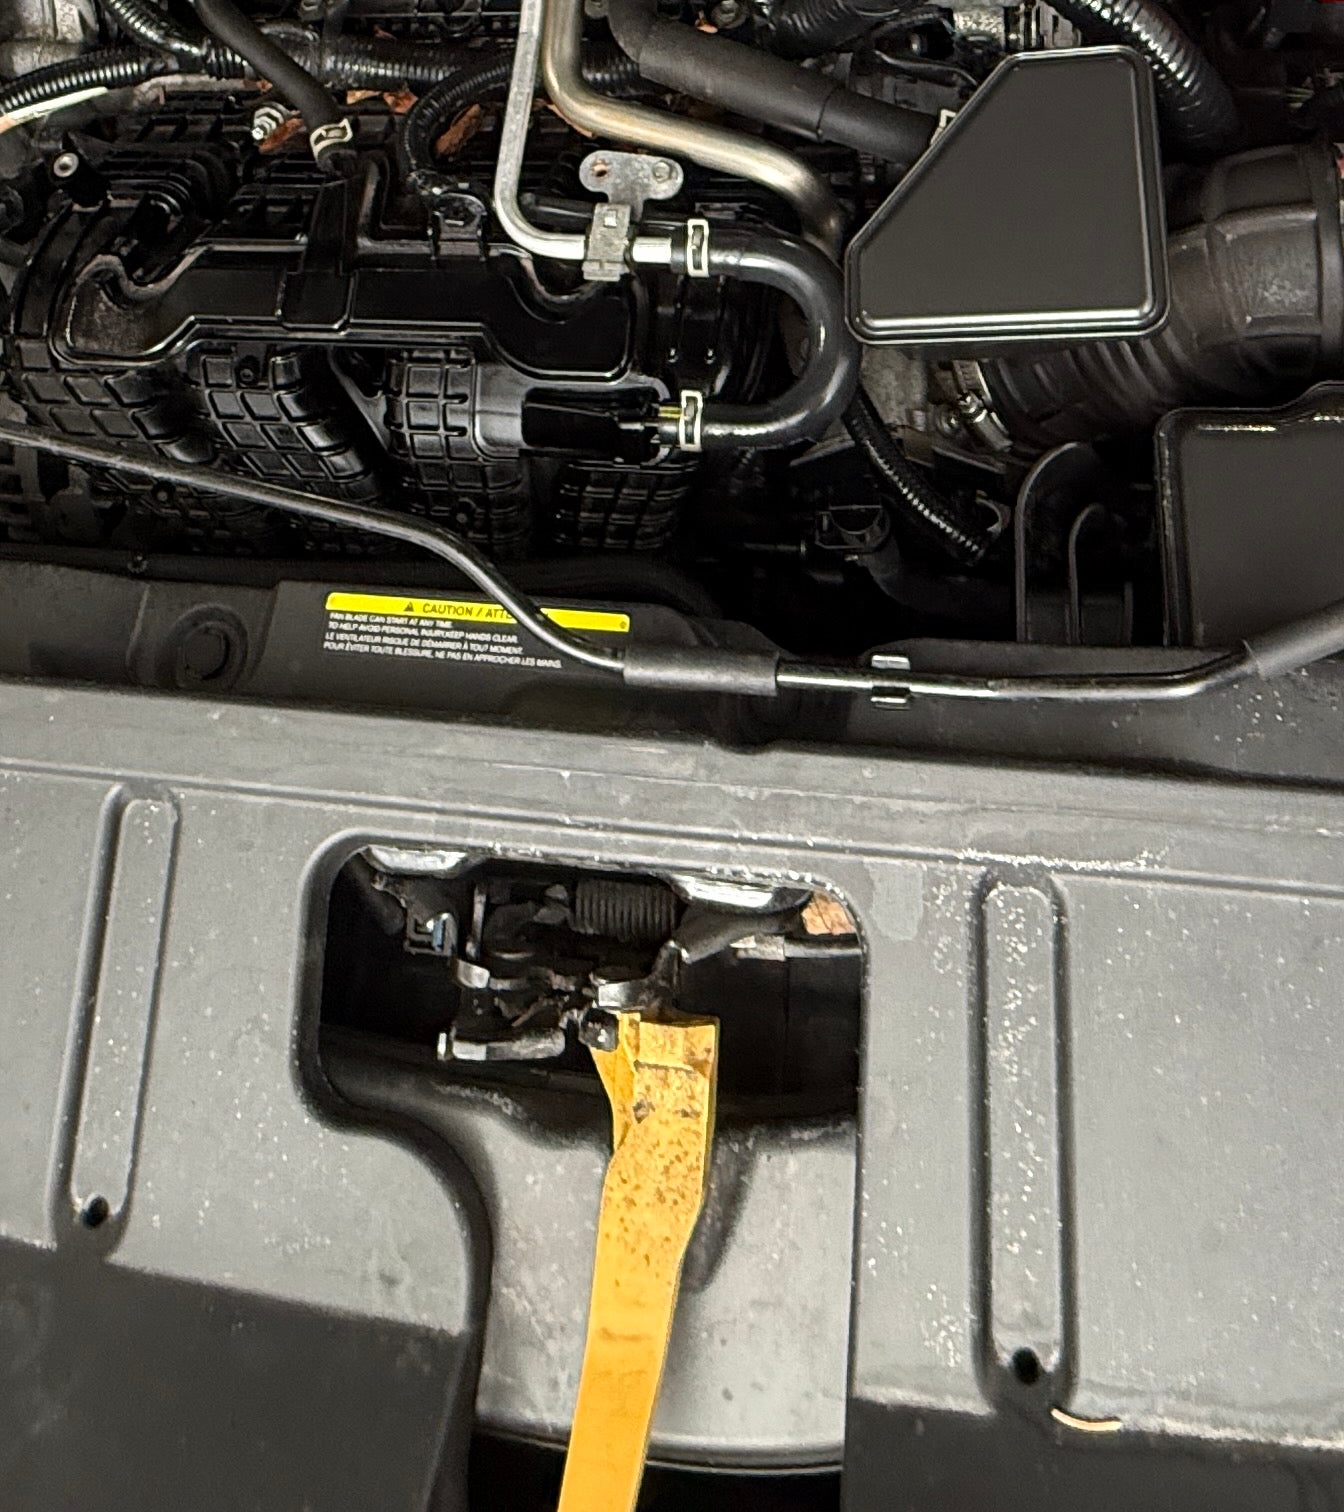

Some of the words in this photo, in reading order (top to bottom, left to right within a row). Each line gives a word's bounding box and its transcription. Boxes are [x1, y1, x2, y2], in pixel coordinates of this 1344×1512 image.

[329, 612, 344, 620] FAN
[345, 613, 369, 622] BLADE
[369, 615, 386, 624] CAN
[386, 616, 408, 625] START
[408, 617, 418, 626] AT
[419, 618, 435, 627] ANY
[422, 603, 473, 616] CAUTION
[328, 621, 339, 629] TO
[339, 622, 359, 631] HELP
[359, 623, 381, 632] AVOID
[381, 625, 419, 636] PERSONAL
[465, 632, 491, 641] HANDS
[325, 632, 335, 640] LE
[336, 632, 382, 643] VENTILATEUR
[382, 635, 409, 646] RISQUE
[409, 638, 420, 647] DE
[421, 638, 462, 650] DÉMARRER
[469, 642, 489, 652] TOUT
[323, 641, 345, 650] POUR
[345, 640, 370, 653] ÉVITER
[371, 645, 393, 655] TOUTE
[435, 650, 445, 659] NE
[447, 651, 461, 661] PAS
[462, 652, 473, 661] EN
[474, 653, 520, 665] APPROCHER
[521, 656, 535, 666] LES
